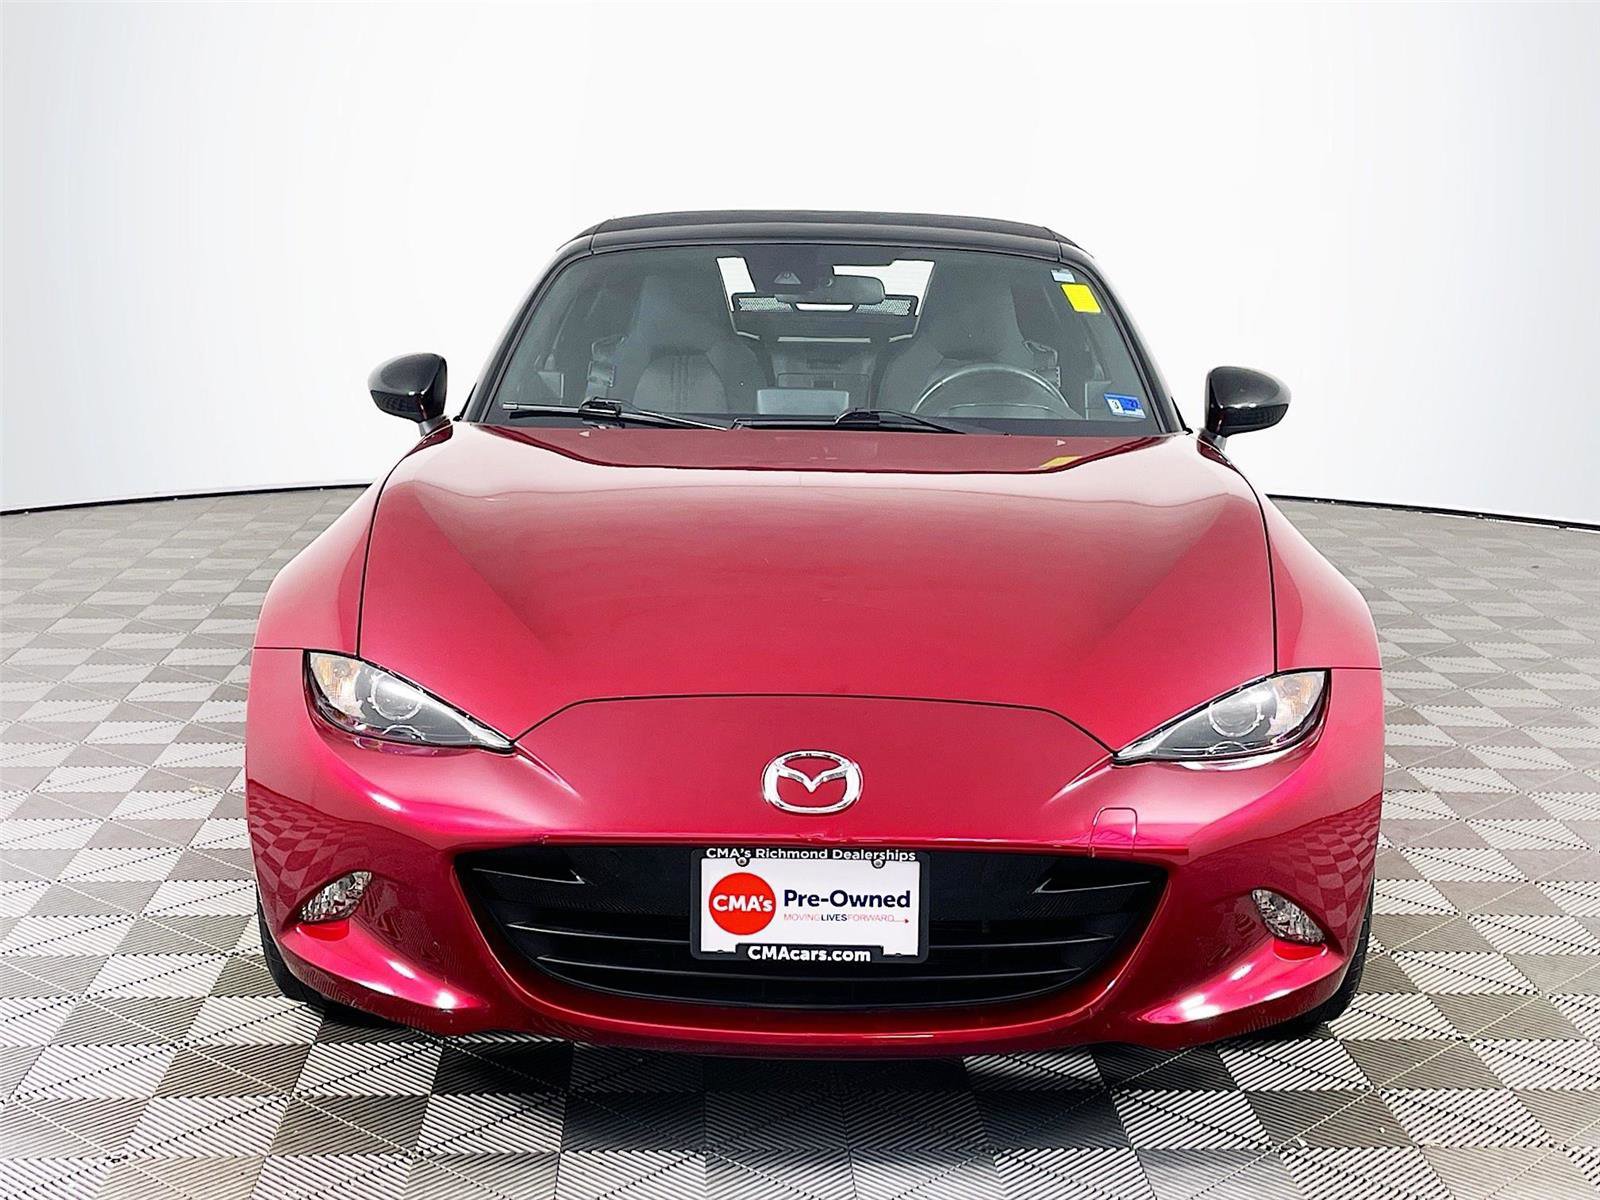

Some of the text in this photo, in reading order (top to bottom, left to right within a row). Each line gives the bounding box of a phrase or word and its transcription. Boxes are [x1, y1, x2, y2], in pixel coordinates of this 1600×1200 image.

[706, 848, 916, 861] CMA's Richmond Dealerships
[712, 894, 773, 912] CMA's
[784, 889, 910, 908] Pre-Owned
[747, 946, 871, 962] CMAcars.com
